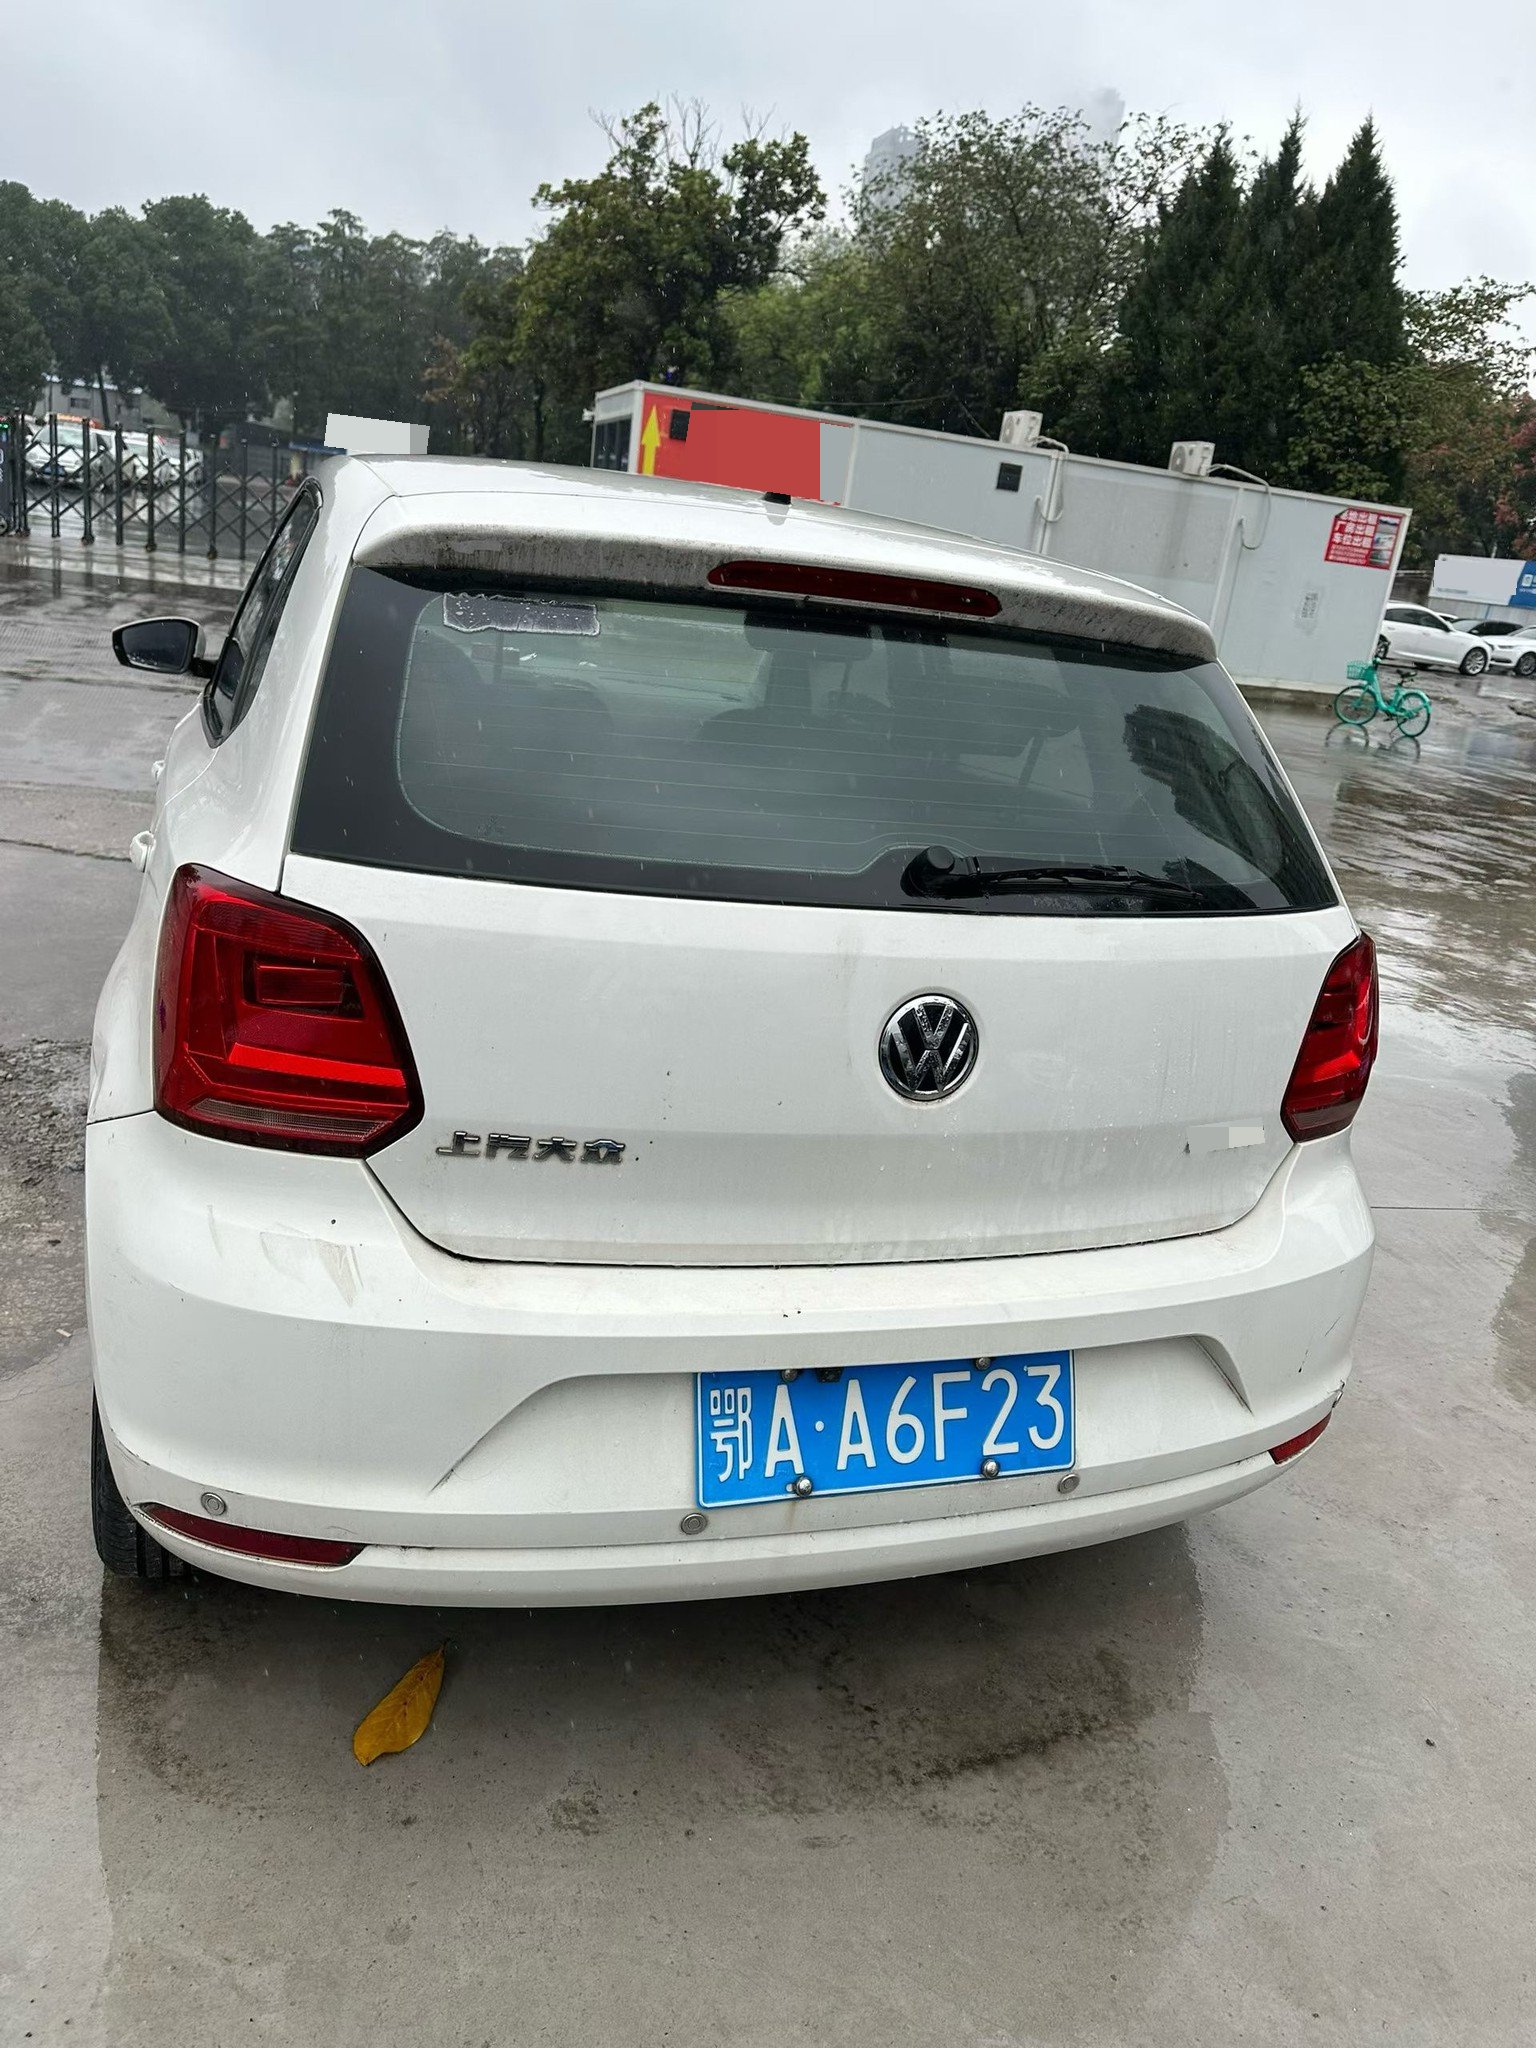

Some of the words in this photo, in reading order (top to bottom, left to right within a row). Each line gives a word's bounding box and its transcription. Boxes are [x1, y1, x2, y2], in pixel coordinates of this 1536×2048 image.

[436, 1130, 626, 1165] 上汽大众
[709, 1363, 1065, 1483] 鄂A·A6F23
